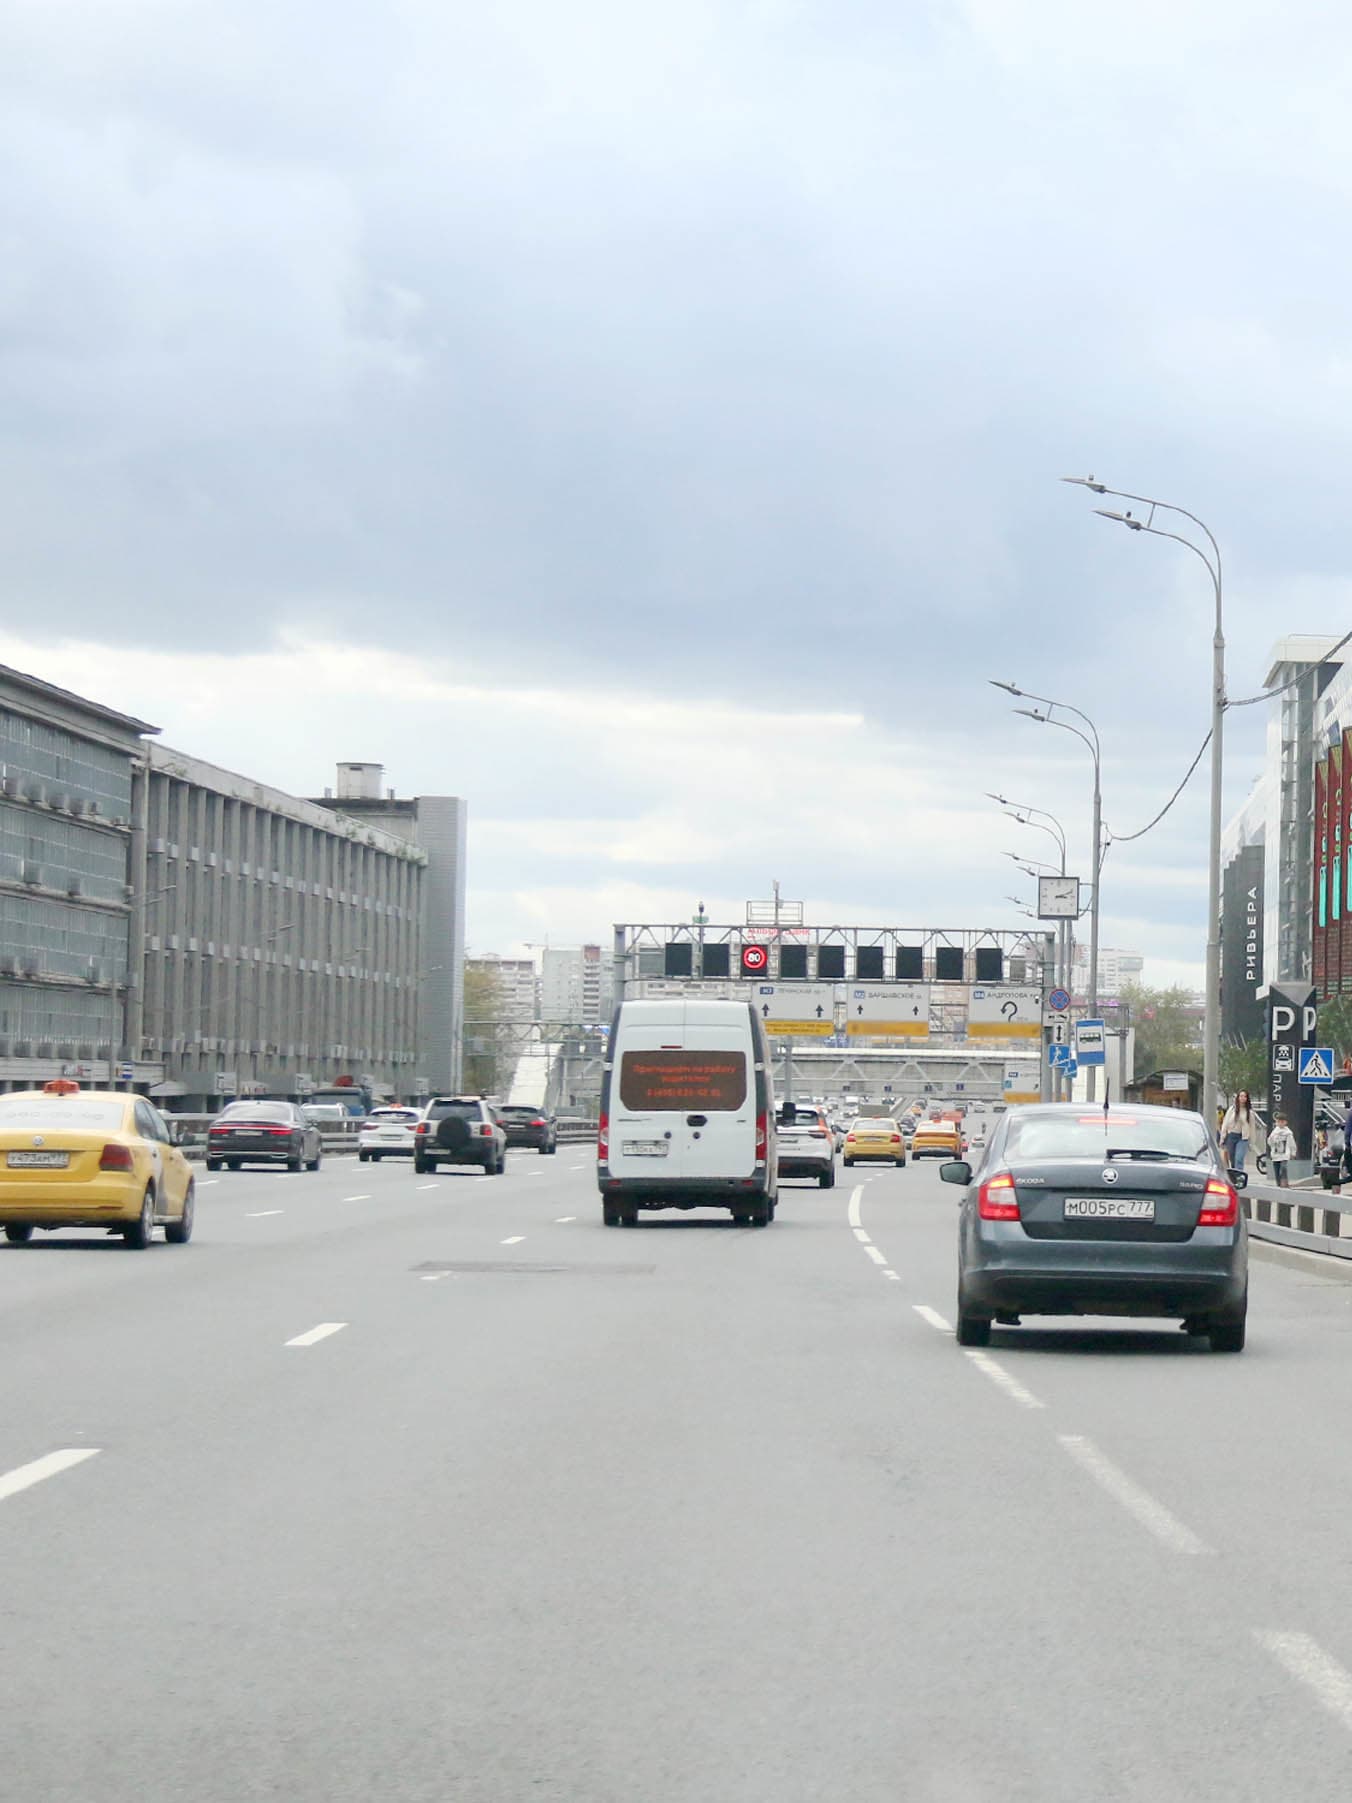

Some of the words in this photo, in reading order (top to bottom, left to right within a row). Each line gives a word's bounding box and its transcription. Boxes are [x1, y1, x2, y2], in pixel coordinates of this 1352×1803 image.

[1246, 886, 1257, 981] РИВЬЕРА
[748, 953, 760, 963] 80
[1272, 1073, 1282, 1121] ПАРКО
